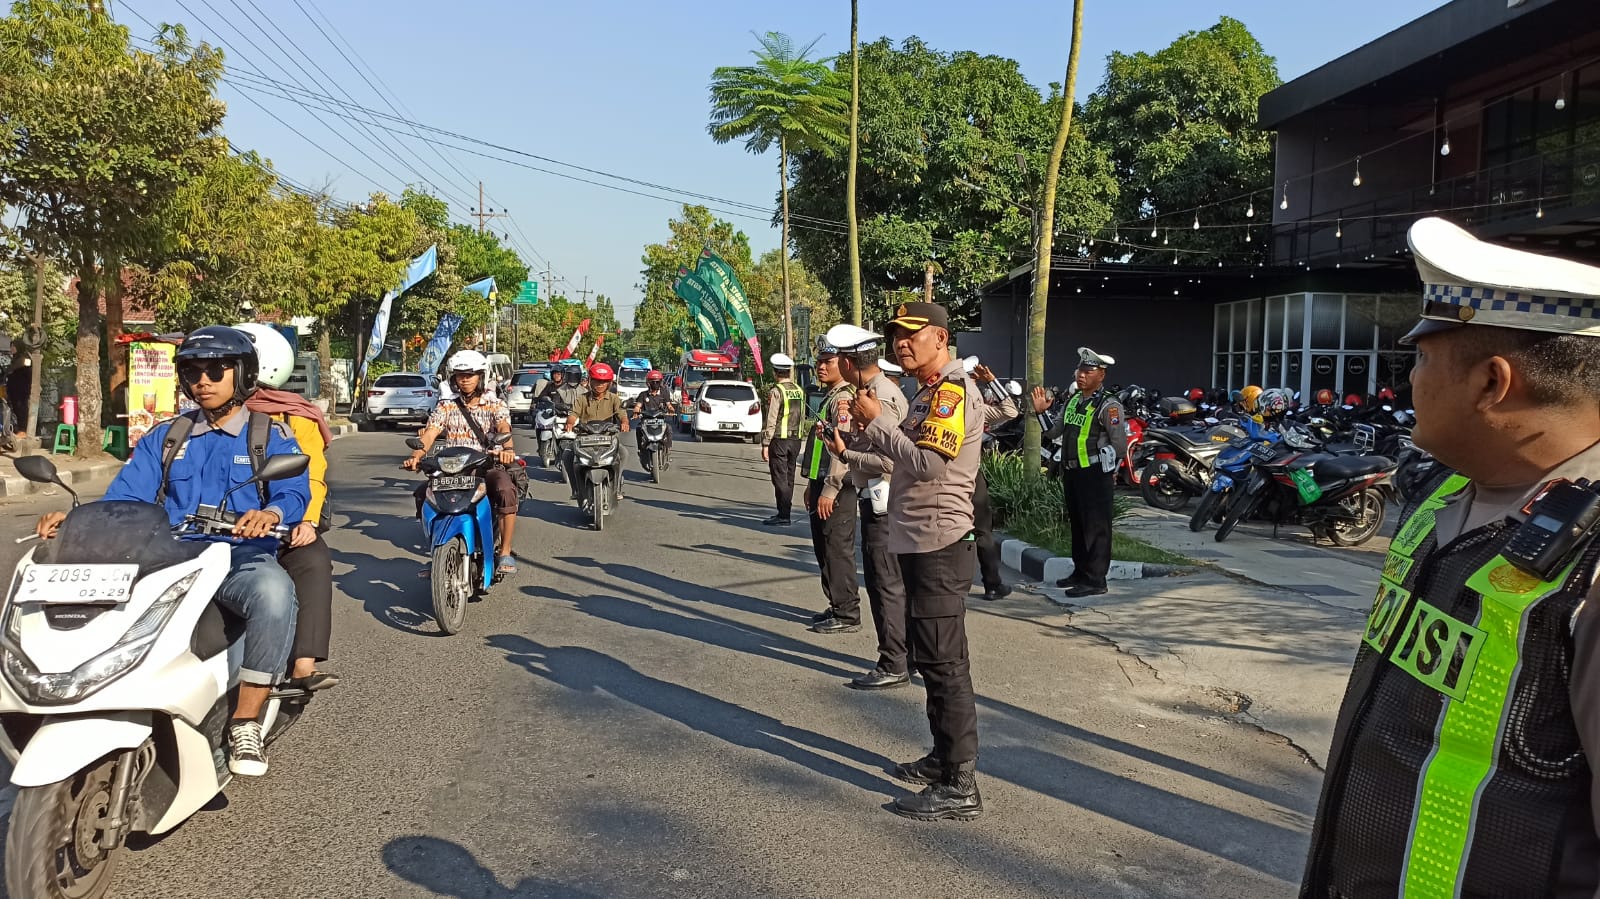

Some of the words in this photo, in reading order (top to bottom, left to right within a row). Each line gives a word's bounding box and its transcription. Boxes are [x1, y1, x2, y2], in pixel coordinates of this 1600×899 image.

[942, 429, 958, 445] WIL
[940, 440, 956, 453] KOTA
[26, 570, 37, 583] S
[48, 568, 91, 582] 2099
